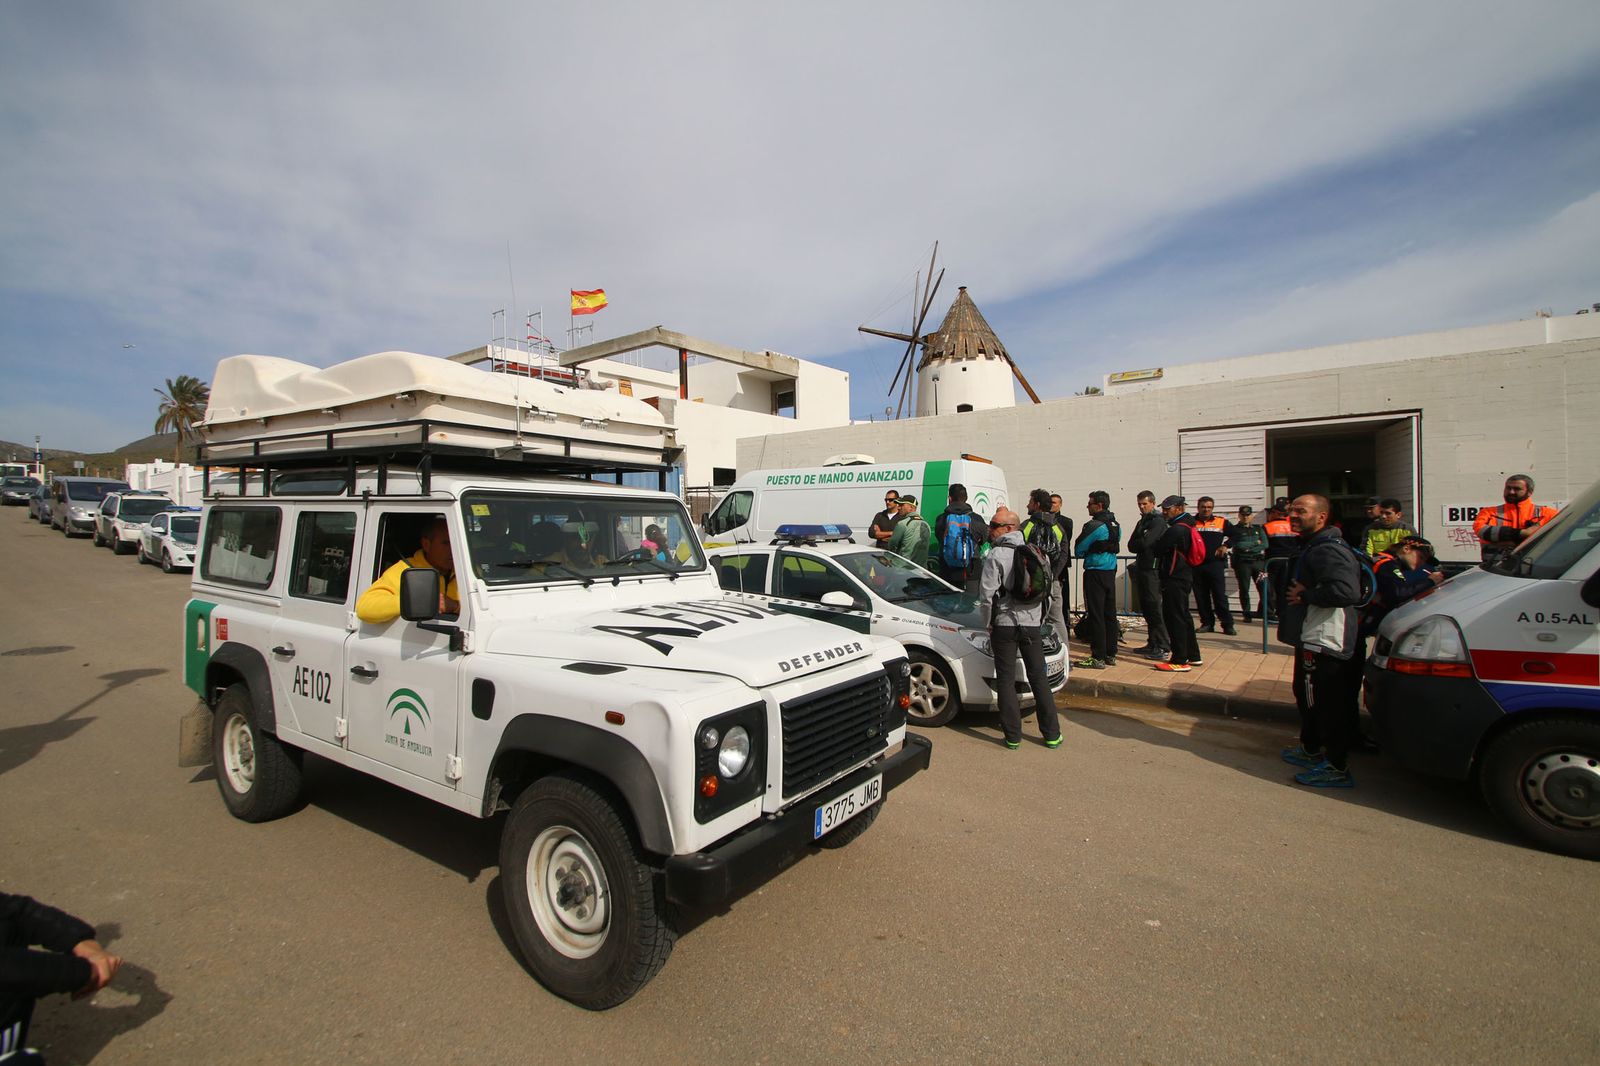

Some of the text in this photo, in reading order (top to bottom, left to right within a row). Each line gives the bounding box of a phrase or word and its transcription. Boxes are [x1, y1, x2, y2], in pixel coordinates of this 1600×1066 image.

[766, 469, 914, 486] PUESTO DE MANDO AVANZADO
[1448, 507, 1484, 522] BIB
[1517, 611, 1594, 625] A 0.5-AL
[777, 641, 863, 673] DEFENDER
[292, 665, 332, 705] AE102
[825, 779, 879, 828] 3775 JMB
